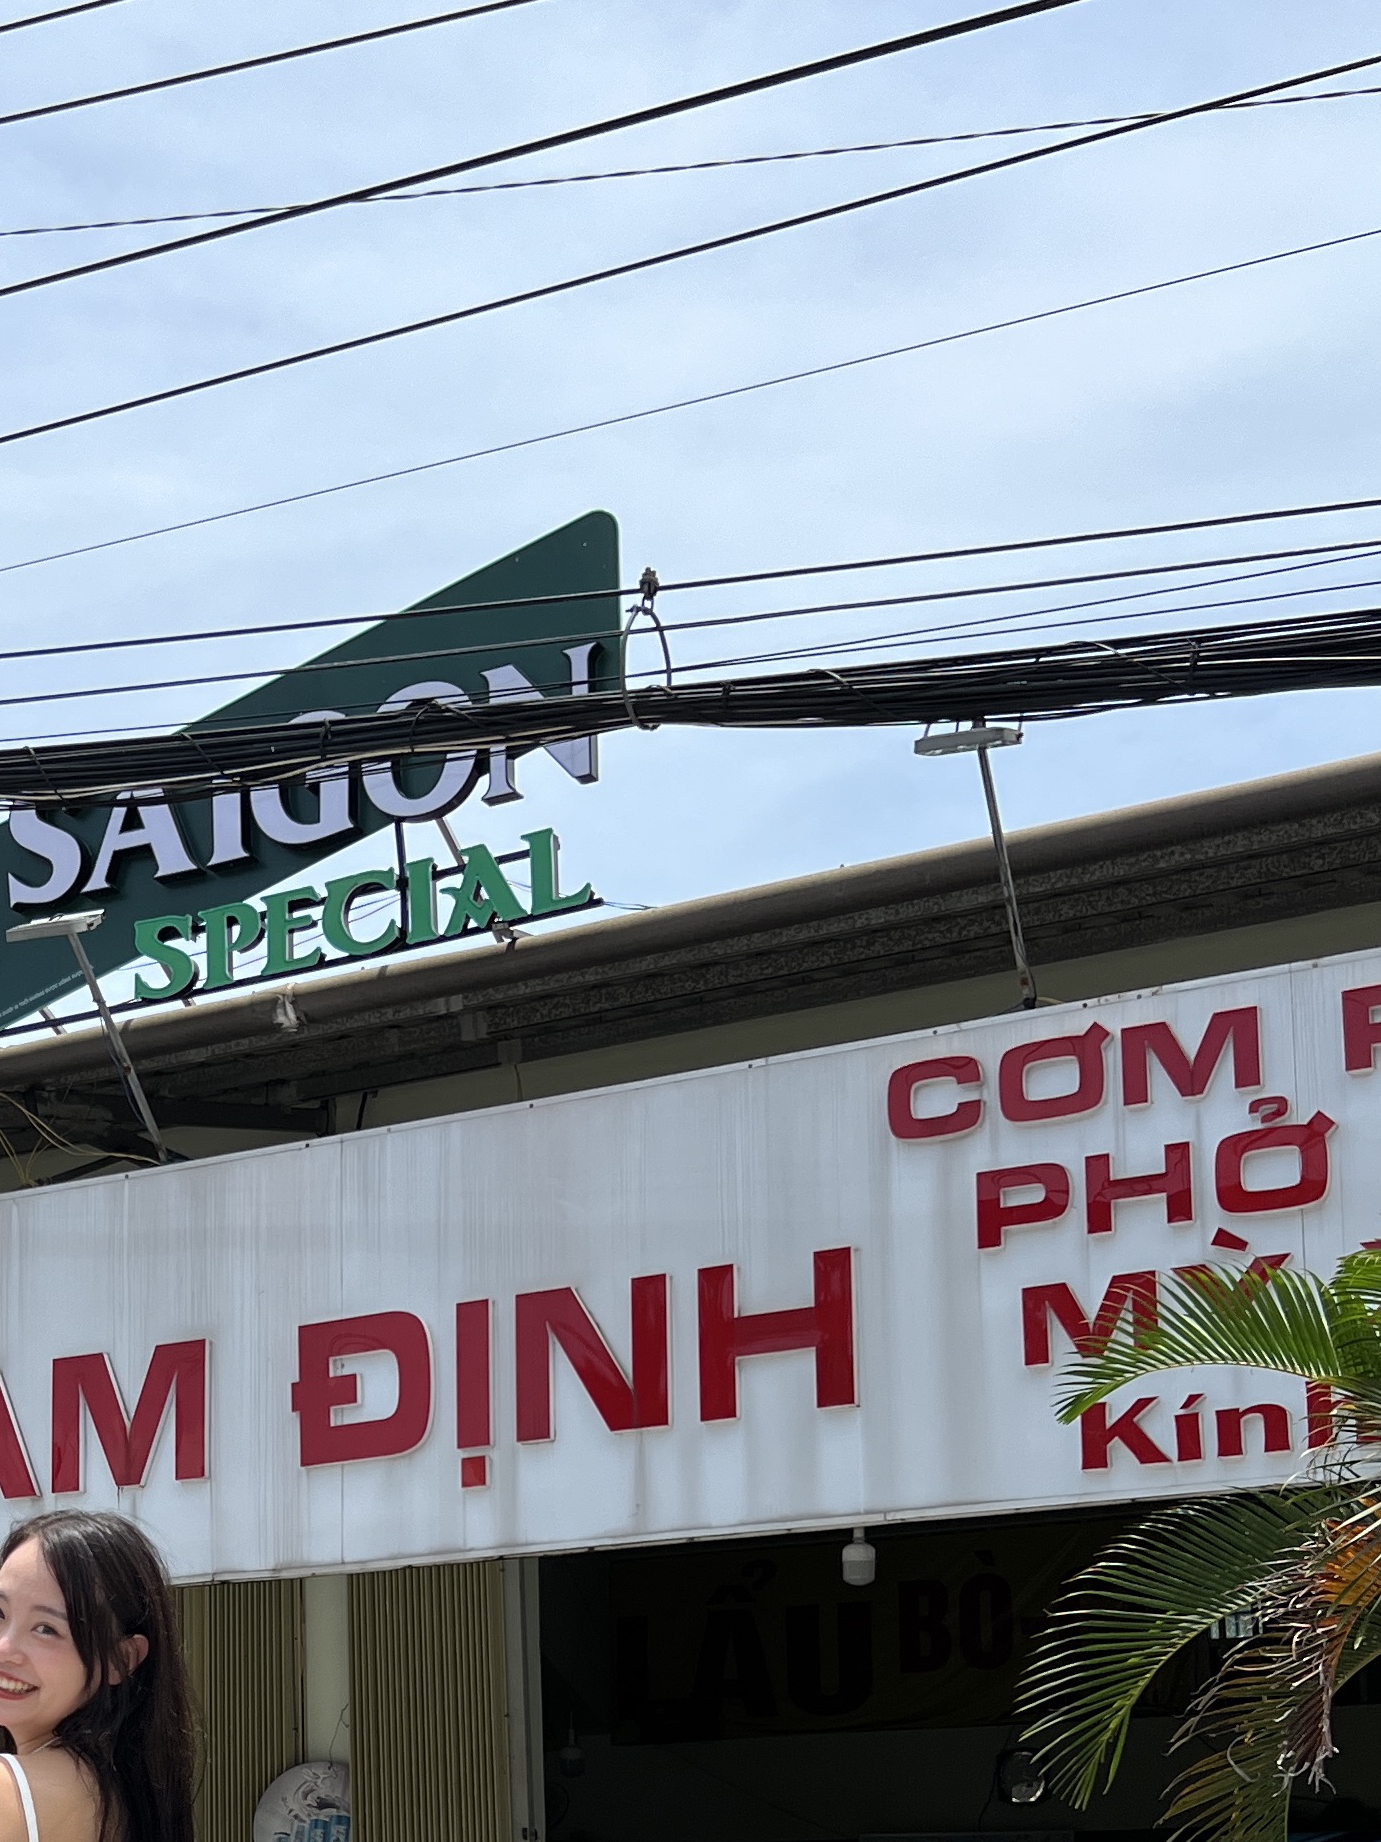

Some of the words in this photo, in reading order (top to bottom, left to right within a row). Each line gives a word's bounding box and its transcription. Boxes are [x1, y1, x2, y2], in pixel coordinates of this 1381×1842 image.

[7, 641, 603, 910] SAIGON
[133, 827, 594, 1002] SPECIAL
[887, 1005, 1261, 1141] CƠM
[975, 1095, 1337, 1251] PHỞ
[291, 1247, 858, 1489] ĐỊNH
[898, 1549, 1014, 1674] BÒ
